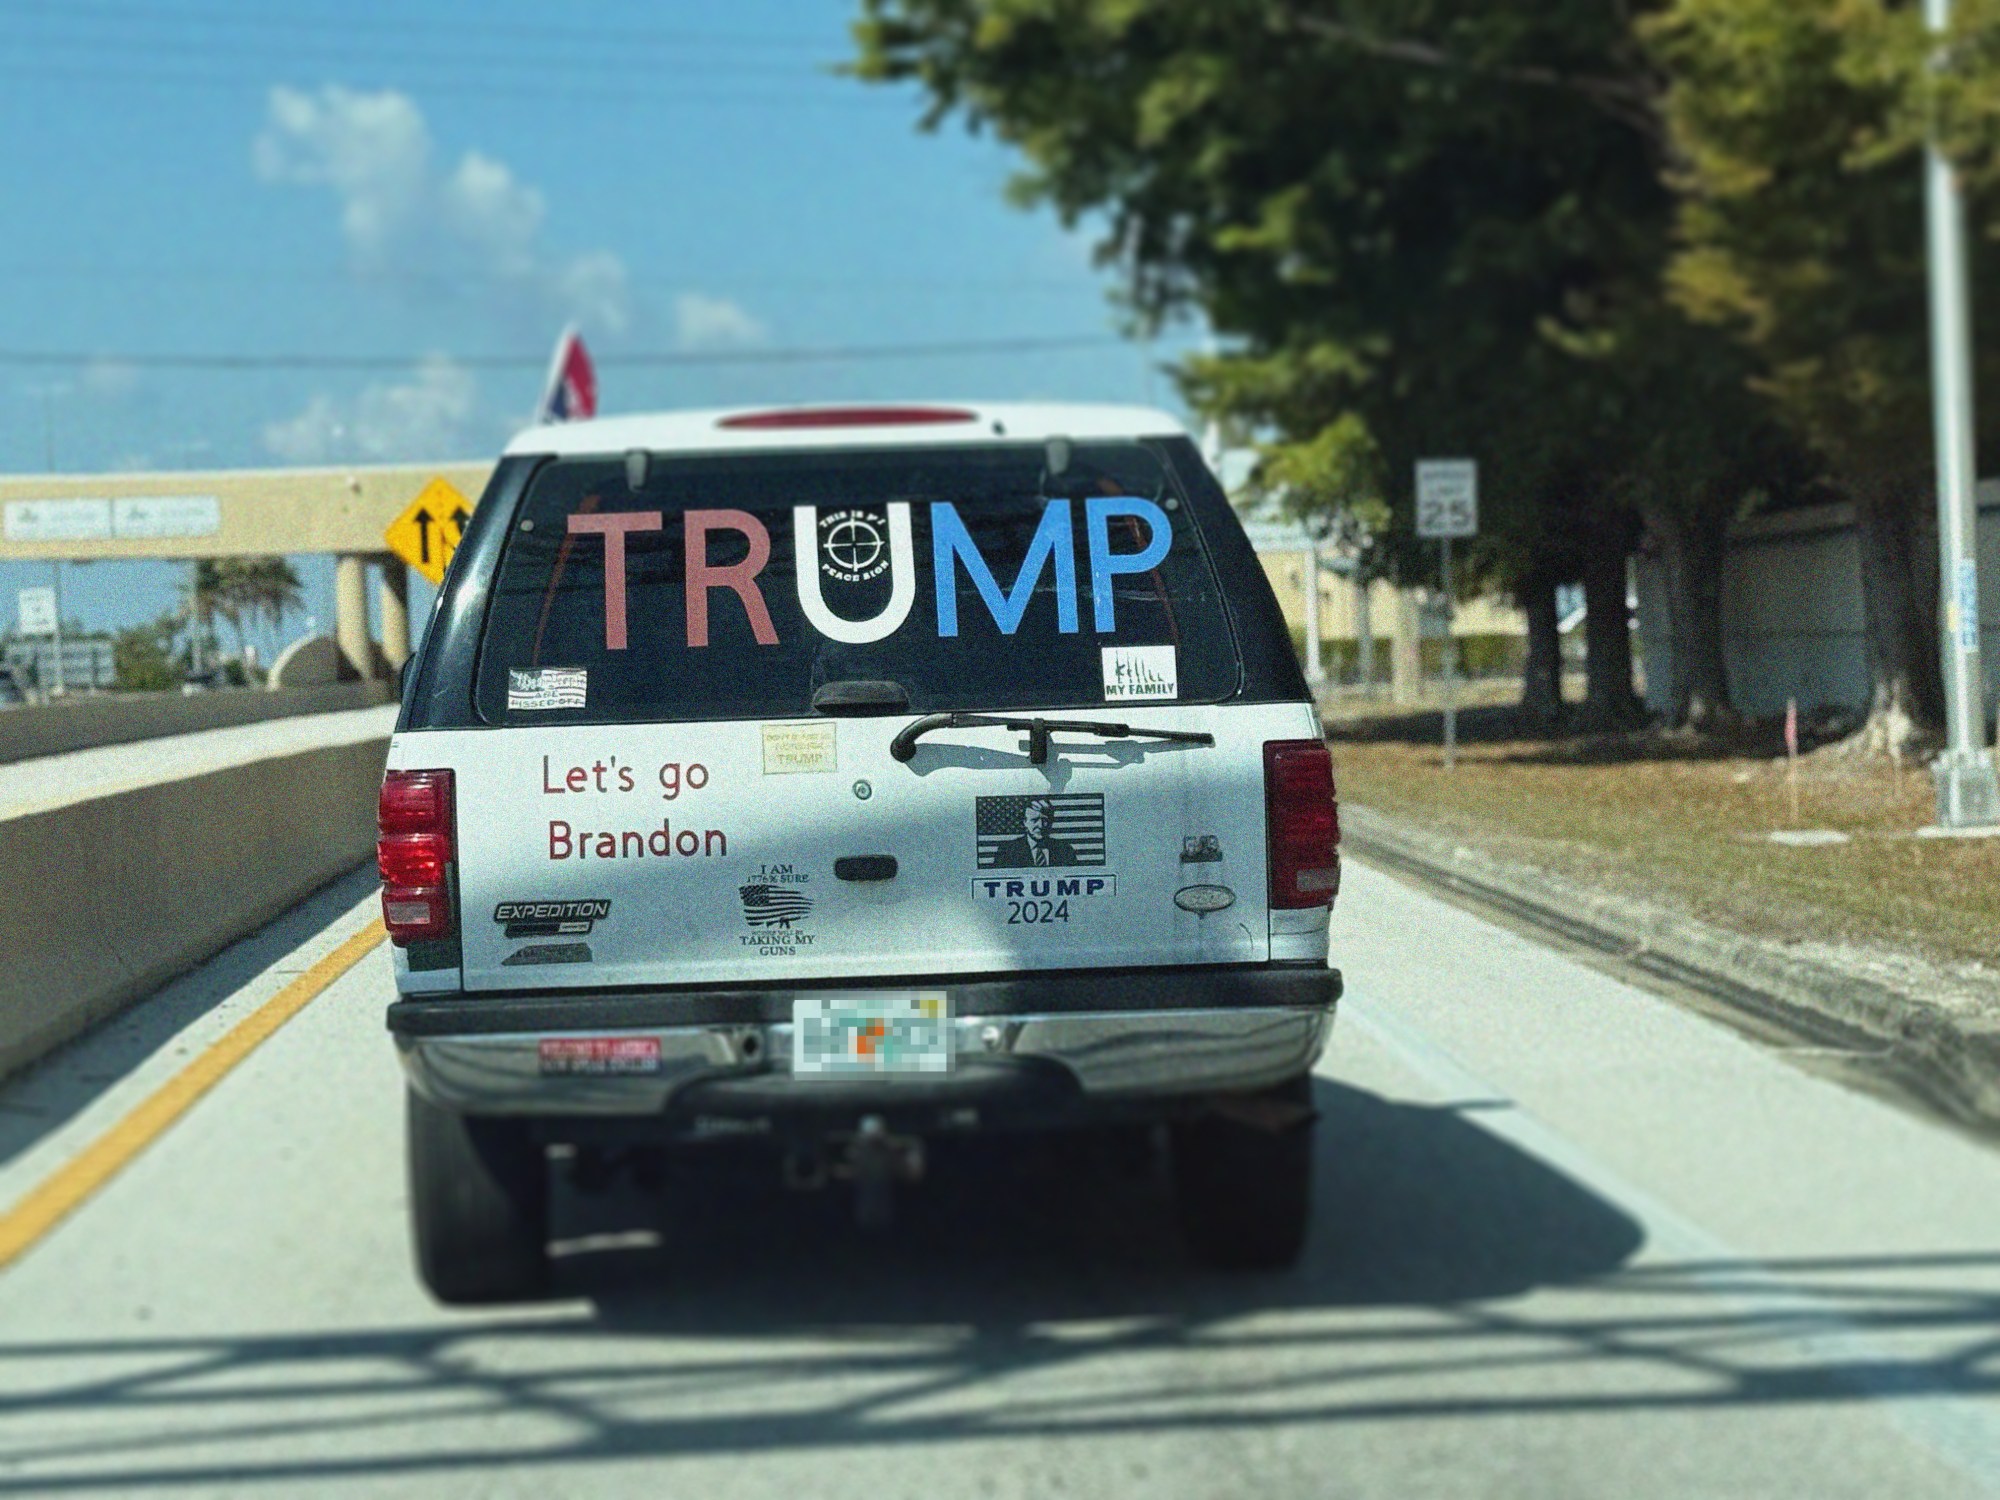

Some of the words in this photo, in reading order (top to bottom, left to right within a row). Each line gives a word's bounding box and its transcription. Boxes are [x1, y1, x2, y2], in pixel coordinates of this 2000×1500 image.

[819, 510, 847, 528] THIS
[567, 496, 1173, 650] TRUMP
[822, 563, 860, 582] PEACE
[863, 560, 889, 580] SIGN
[1106, 684, 1125, 695] MY
[1129, 683, 1174, 695] FAMILY
[776, 753, 823, 765] TRUMP
[543, 755, 635, 794] Let's
[659, 762, 709, 800] go
[549, 817, 727, 860] Brandon
[761, 864, 767, 875] I
[771, 864, 793, 875] AM
[780, 873, 809, 883] SURE
[984, 878, 1105, 899] TRUMP
[496, 902, 608, 920] EXPEDITION
[1007, 900, 1070, 924] 2024
[739, 934, 791, 946] TAKING
[795, 934, 815, 945] MY
[760, 946, 796, 956] GUNS
